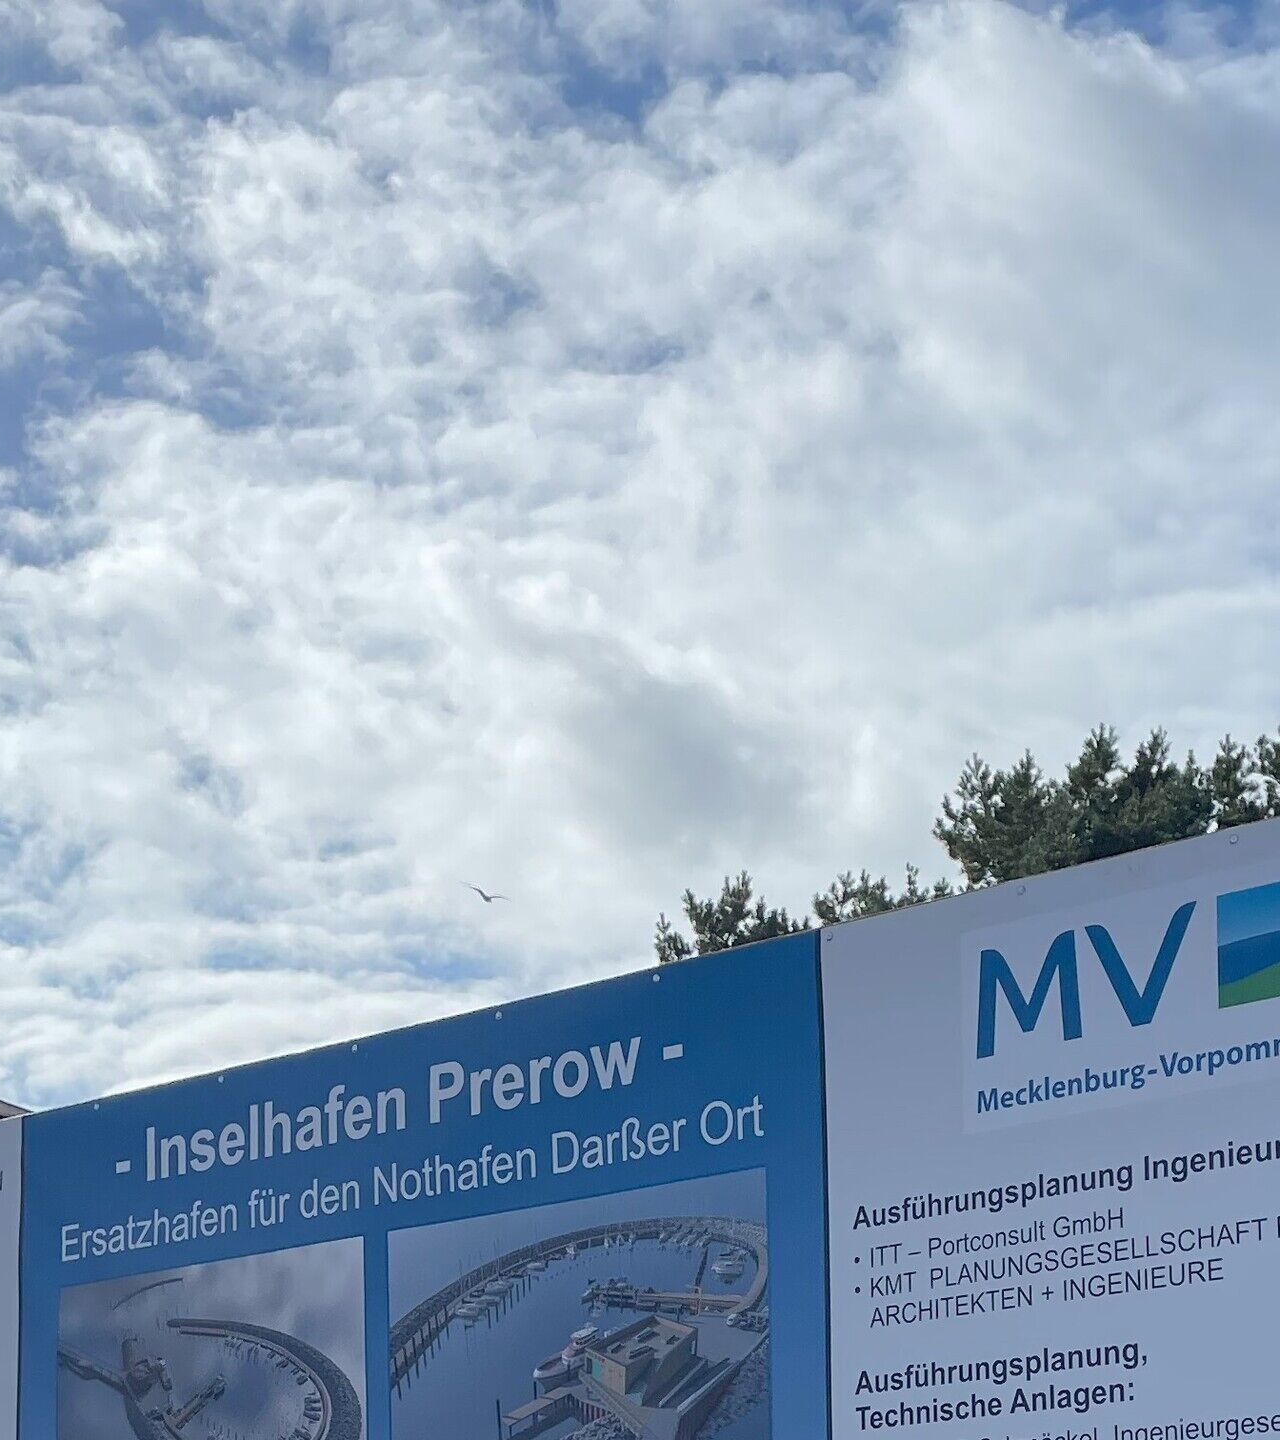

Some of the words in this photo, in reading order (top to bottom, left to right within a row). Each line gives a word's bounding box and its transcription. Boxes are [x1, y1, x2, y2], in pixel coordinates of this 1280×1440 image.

[975, 900, 1197, 1060] MV
[146, 1084, 406, 1182] Inselhafen
[429, 1036, 642, 1124] Prerow
[61, 1199, 237, 1263] Ersatzhafen
[247, 1188, 291, 1229] für
[299, 1178, 360, 1219] den
[373, 1144, 537, 1206] Nothafen
[551, 1117, 687, 1175] Darßer
[699, 1094, 765, 1145] Ort
[852, 1164, 1133, 1231] Ausführungsplanung
[870, 1242, 903, 1269] ITT
[928, 1220, 1047, 1259] Portconsult
[1053, 1207, 1124, 1239] GmbH
[870, 1270, 917, 1299] KMT
[929, 1217, 1268, 1290] PLANUNGSGESELLSCHAFT
[869, 1284, 1033, 1329] ARCHITEKTEN
[1063, 1257, 1225, 1302] INGENIEURE
[854, 1343, 1147, 1396] Ausführungsplanung,
[855, 1393, 1003, 1431] Technische
[1009, 1381, 1135, 1415] Anlagen:
